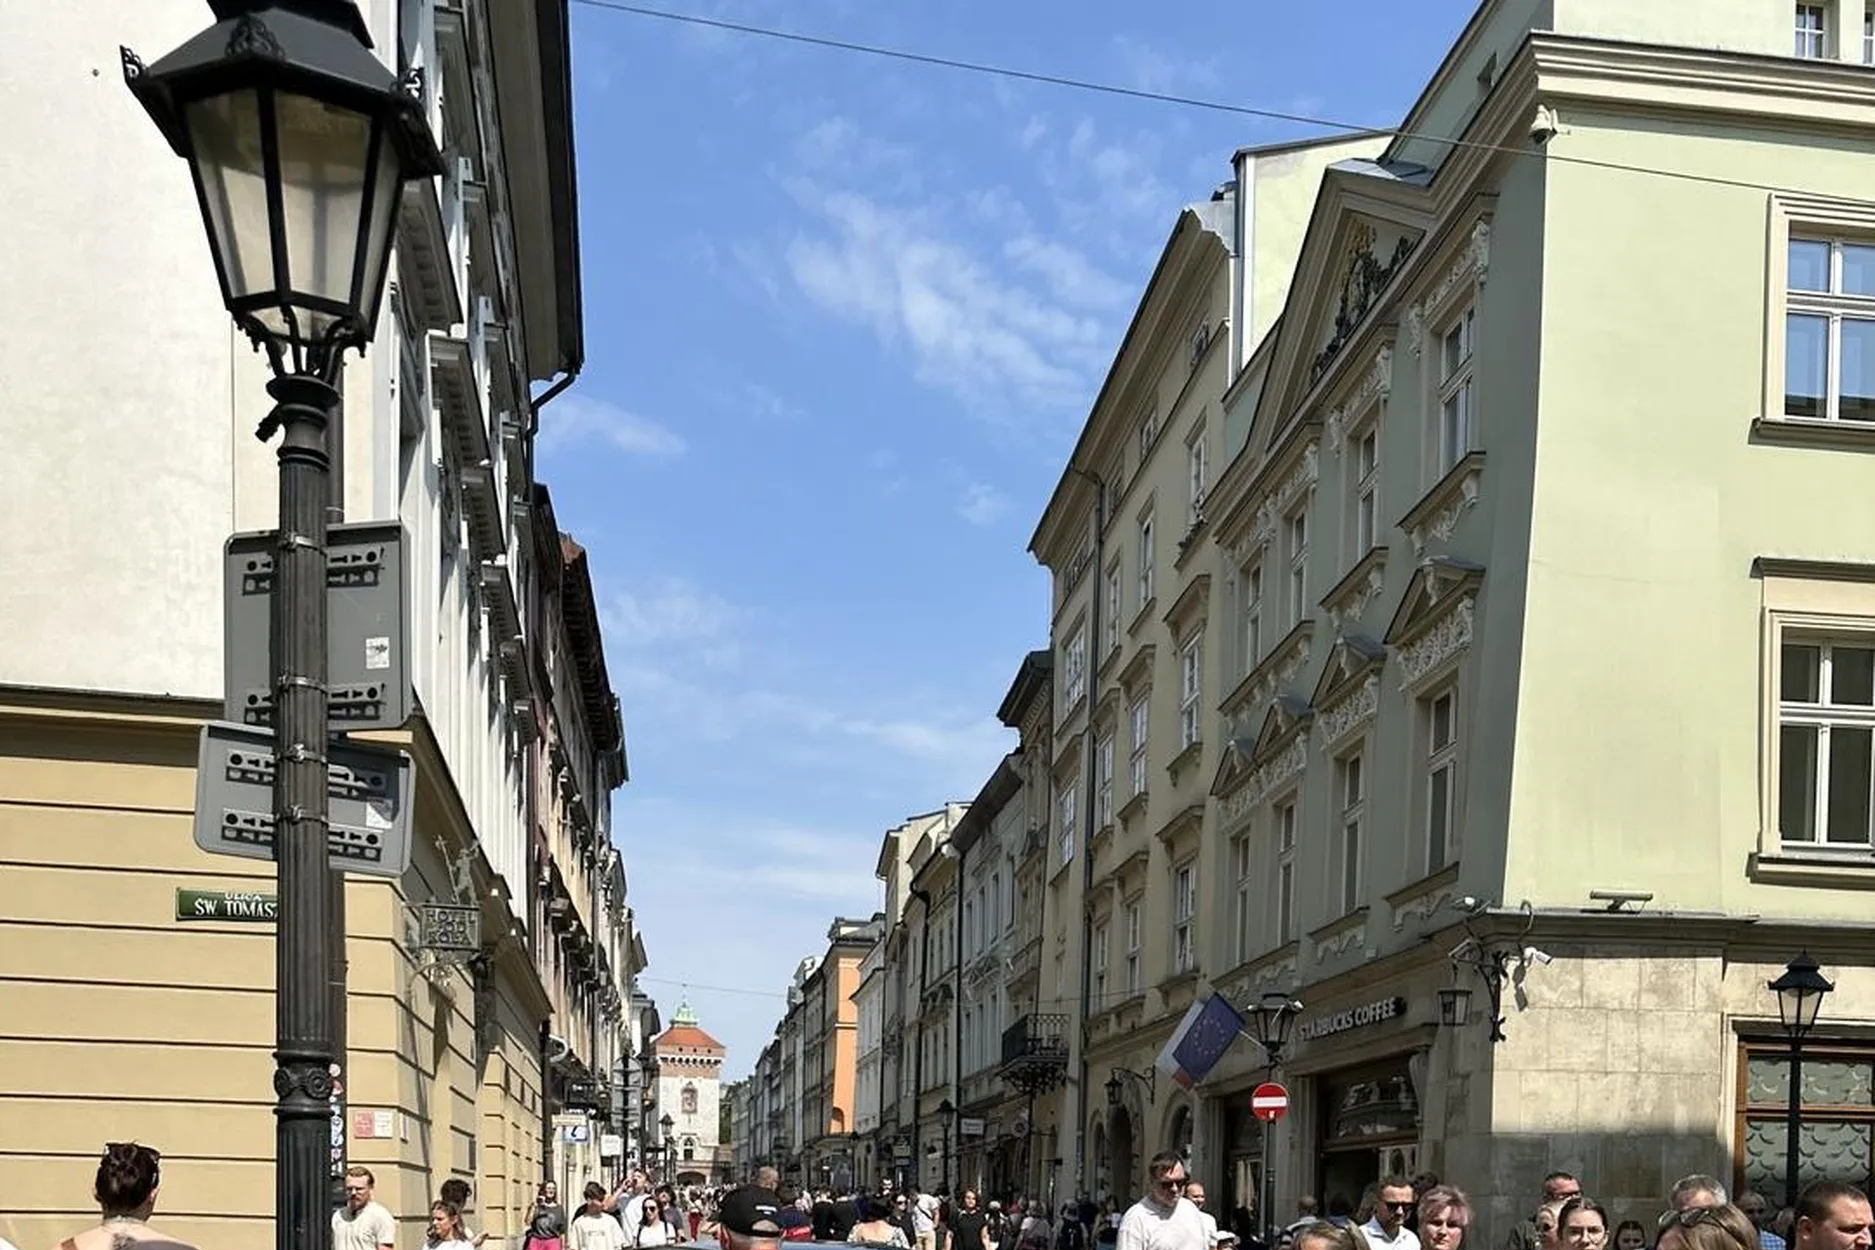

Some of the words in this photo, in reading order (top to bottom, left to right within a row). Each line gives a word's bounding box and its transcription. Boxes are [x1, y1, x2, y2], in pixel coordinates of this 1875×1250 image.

[223, 900, 278, 918] TOMAS
[1299, 1010, 1354, 1041] STARBUCKS
[1354, 996, 1397, 1026] COFFEE
